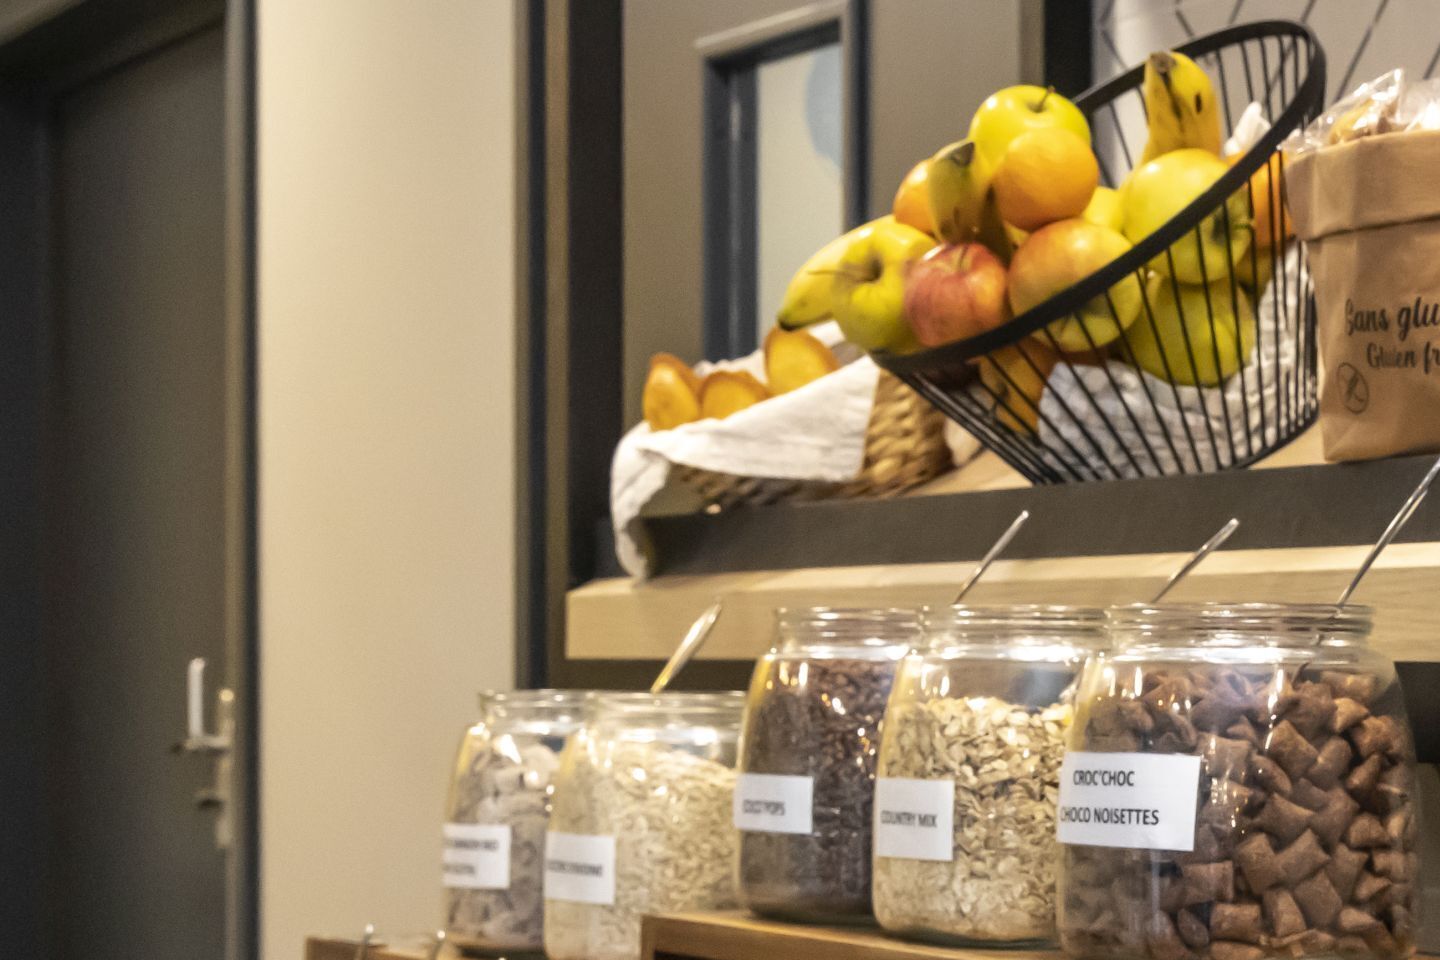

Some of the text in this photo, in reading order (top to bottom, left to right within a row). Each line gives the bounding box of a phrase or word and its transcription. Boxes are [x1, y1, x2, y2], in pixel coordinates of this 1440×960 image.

[1345, 298, 1389, 335] Sans
[1074, 770, 1134, 786] CROC'CHOC
[918, 813, 938, 828] MIX
[1061, 807, 1159, 825] CHOCO NOISETTES
